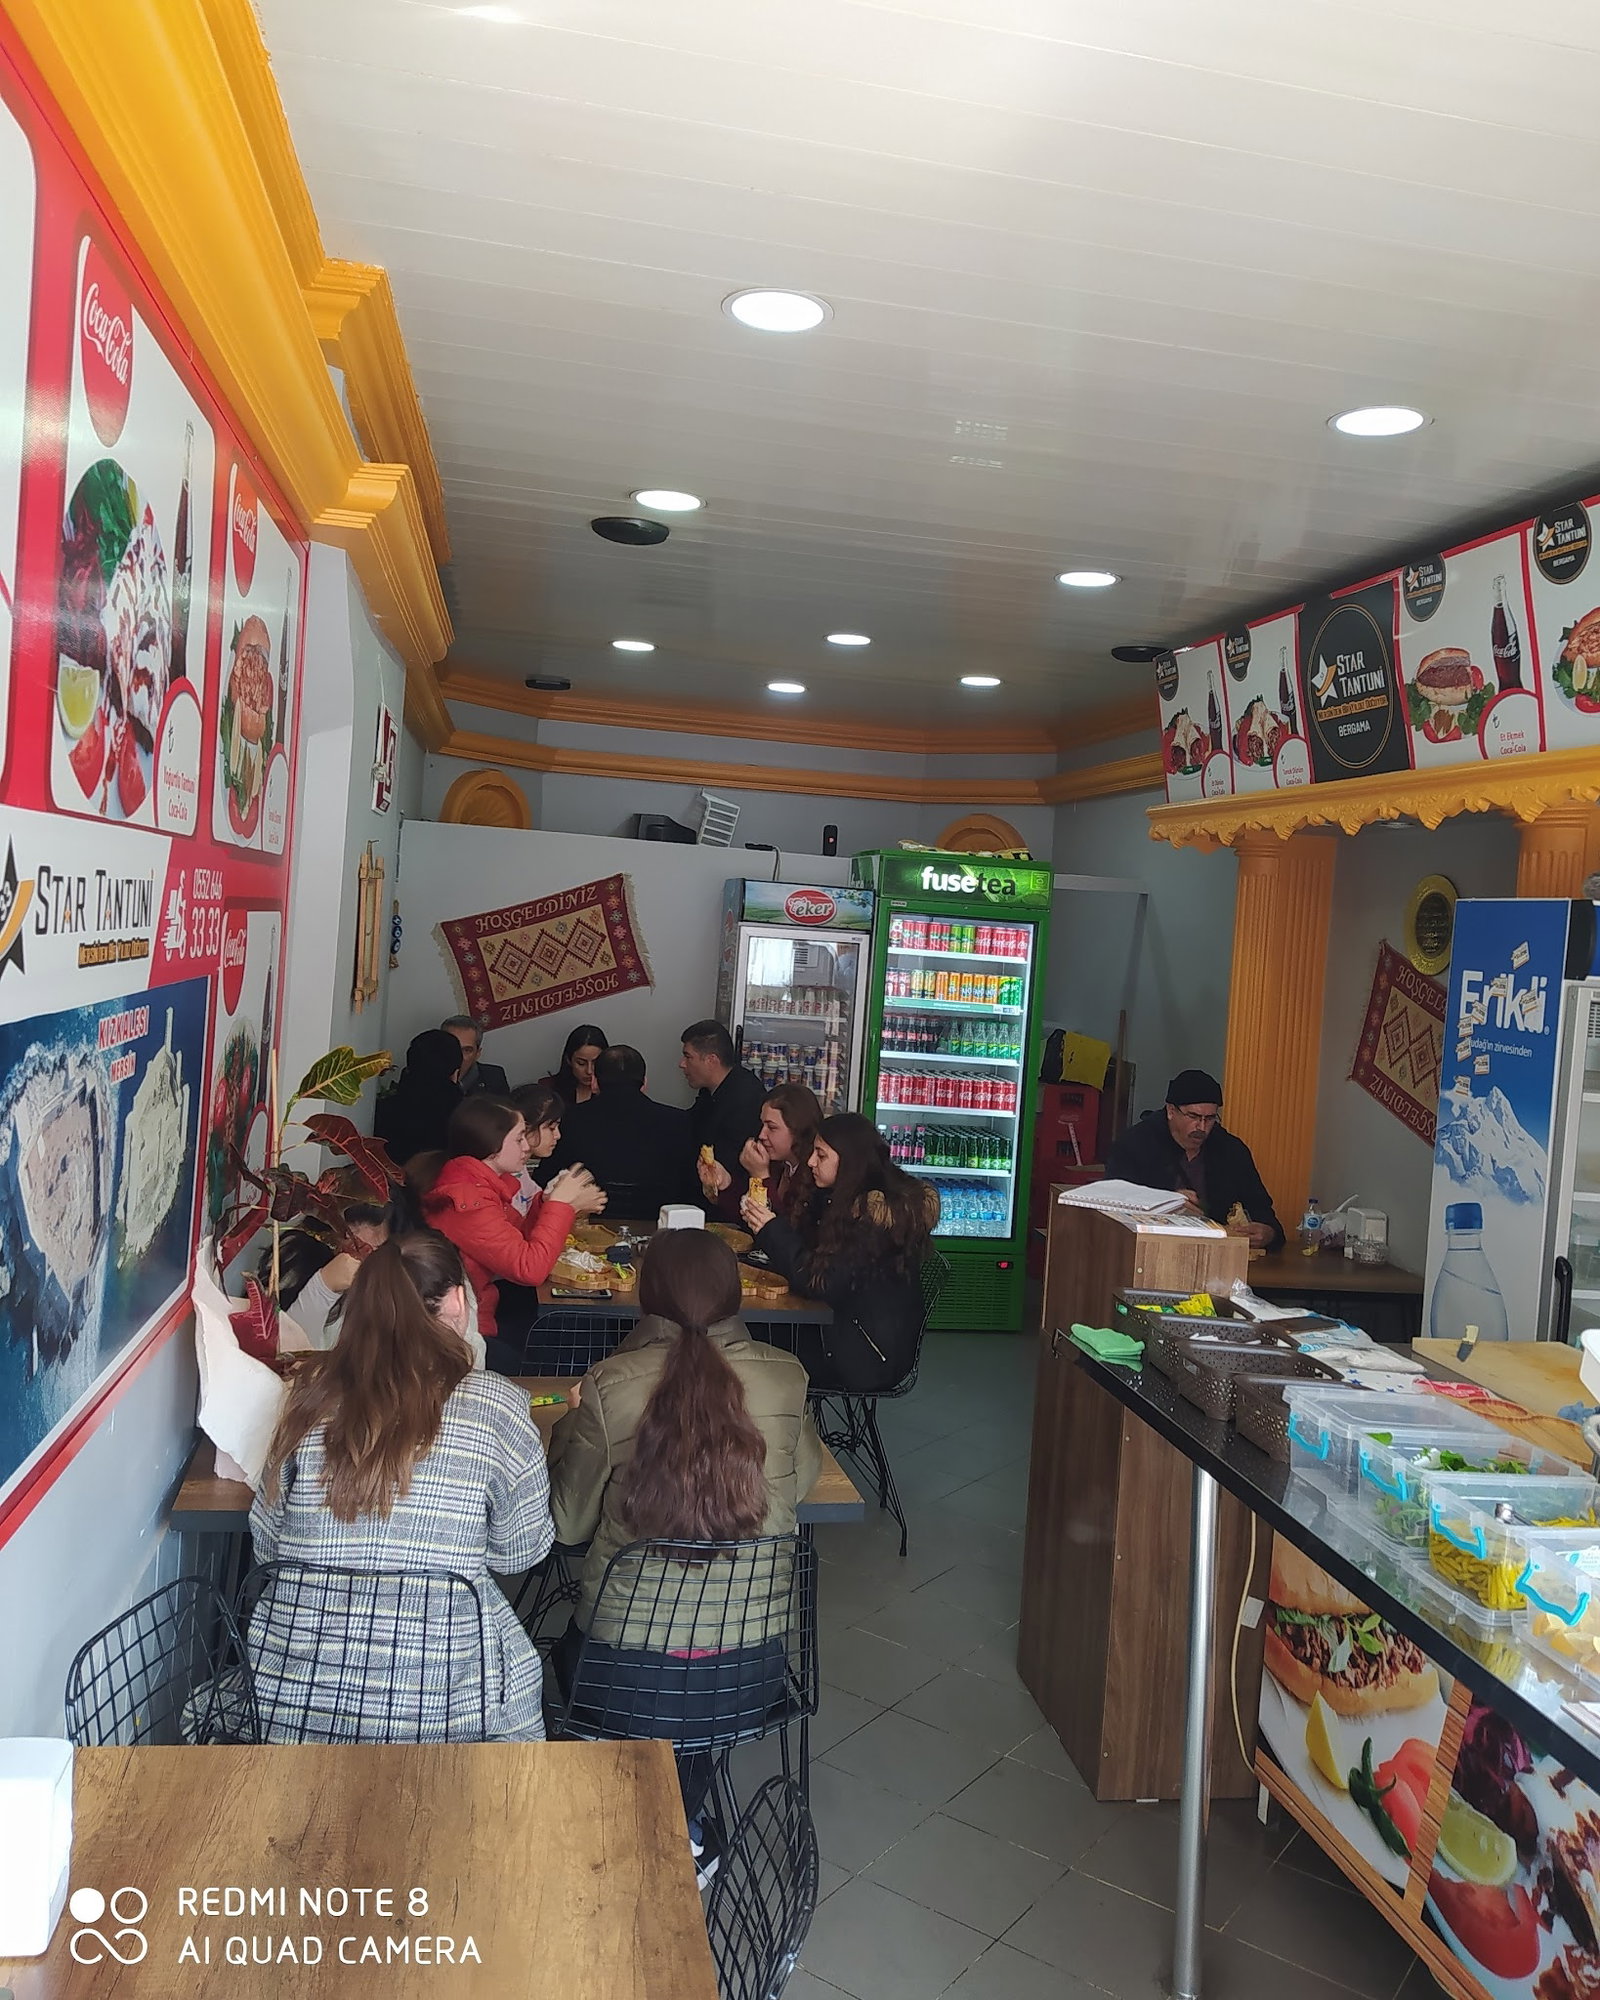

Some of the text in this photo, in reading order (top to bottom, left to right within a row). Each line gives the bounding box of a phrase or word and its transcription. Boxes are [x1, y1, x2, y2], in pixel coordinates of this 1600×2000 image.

[1554, 518, 1574, 534] STAR
[1337, 651, 1366, 676] STAR
[1338, 720, 1372, 737] BERGAMA
[1500, 744, 1526, 756] Coca-Cola
[193, 868, 223, 900] 0552 646
[35, 865, 86, 935] STAR
[475, 886, 598, 934] HOŞGELDİNİZ
[190, 906, 220, 959] 33 33
[1494, 1041, 1533, 1058] zirvesinden
